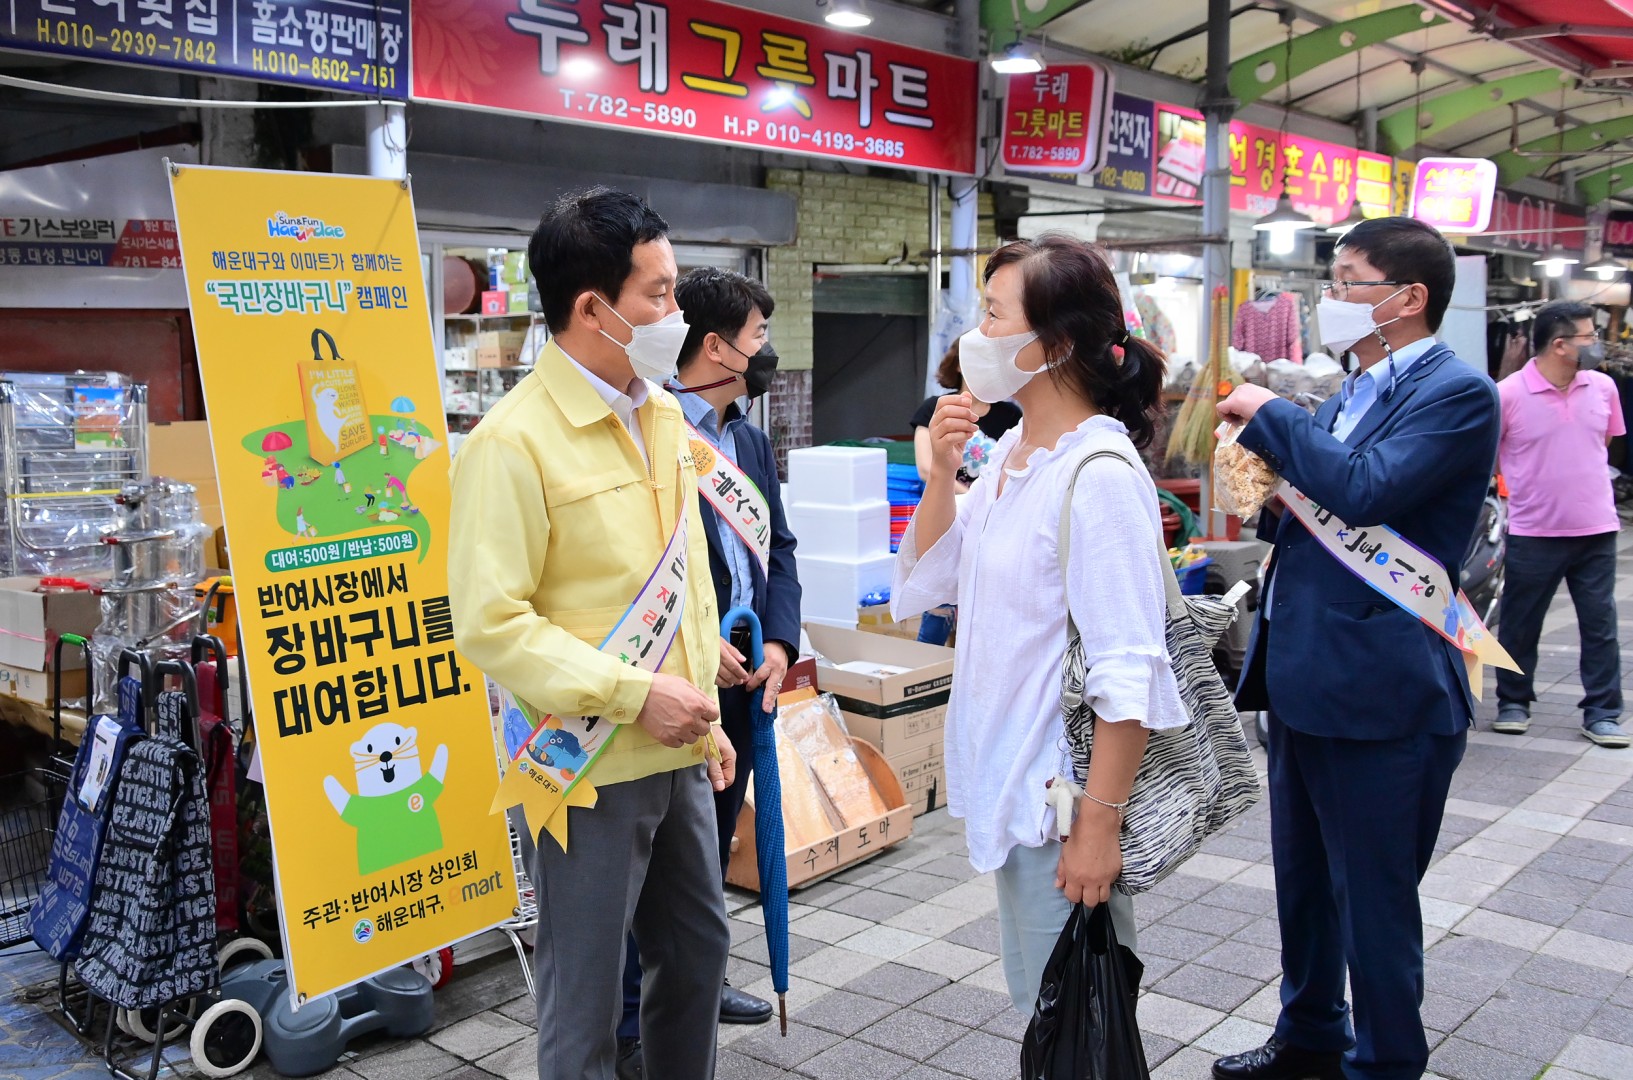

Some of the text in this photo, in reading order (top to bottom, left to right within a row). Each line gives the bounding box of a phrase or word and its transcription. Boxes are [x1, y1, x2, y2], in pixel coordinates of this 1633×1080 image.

[37, 18, 217, 64] H.010-2939-7842
[251, 0, 403, 64] 홈쇼핑판매장
[252, 52, 396, 89] H.010-8502-7151
[1033, 72, 1069, 103] 두래
[558, 88, 698, 129] T.782-5890
[1010, 109, 1083, 140] 그릇마트
[723, 116, 905, 158] H.P 010-4193-3685
[1010, 145, 1080, 161] T.782-5890
[19, 218, 116, 239] 가스보일러
[278, 215, 319, 227] Sun&Fun
[212, 251, 403, 272] 해운대구와 이마트가 함께하는
[357, 286, 408, 310] 캠페인
[341, 424, 366, 441] SAVE
[257, 563, 409, 619] 반여시장에서
[266, 595, 455, 675] 장바구니를
[273, 650, 471, 738] 대여합니다.
[528, 767, 558, 794] 해운대구
[804, 817, 890, 871] 수제 도마
[428, 850, 478, 885] 상인회
[376, 870, 504, 932] 해운대구, emart
